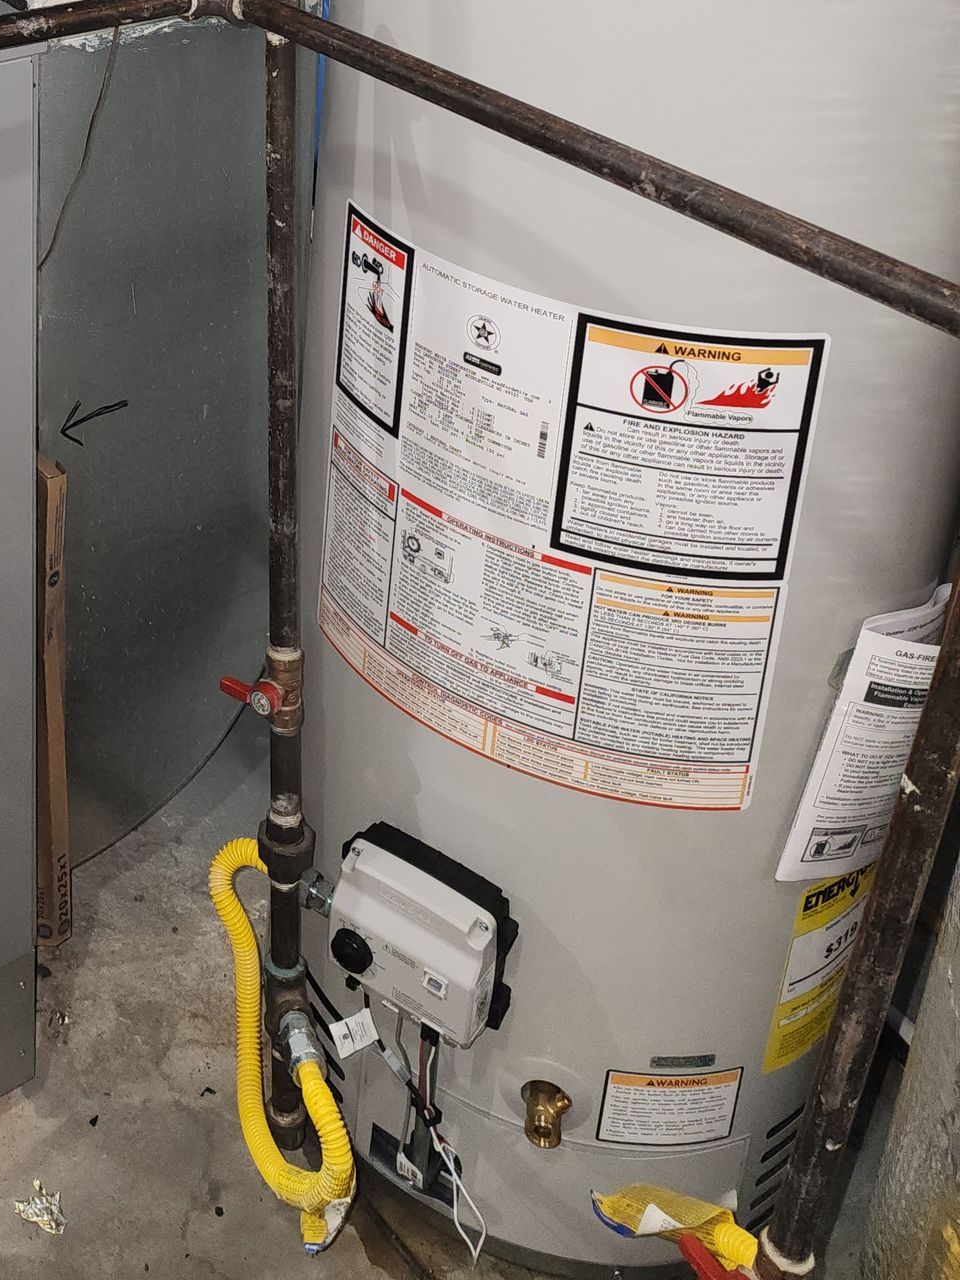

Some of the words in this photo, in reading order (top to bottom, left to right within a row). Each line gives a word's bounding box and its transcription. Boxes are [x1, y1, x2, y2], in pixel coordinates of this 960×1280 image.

[364, 231, 397, 261] DANGER
[422, 262, 461, 286] AUTOMATIC
[462, 282, 498, 300] STORAGE
[500, 296, 529, 311] WATER
[531, 306, 565, 321] HEATER
[674, 346, 741, 361] WARNING
[687, 411, 726, 420] Flammable
[728, 414, 752, 422] Vapors
[662, 426, 709, 437] EXPLOSION
[712, 431, 745, 439] HAZARD
[669, 434, 692, 442] serious
[583, 431, 602, 440] liquids
[624, 440, 645, 449] vicinity
[659, 439, 686, 448] gasoline
[603, 443, 629, 452] gasoline
[657, 452, 690, 462] flammable
[610, 450, 621, 458] any
[641, 457, 671, 465] appliance
[447, 517, 483, 538] OPERATING
[484, 534, 534, 558] INSTRUCTIONS
[677, 588, 714, 596] WARNING
[673, 612, 710, 620] WARNING
[424, 635, 433, 643] TO
[434, 639, 450, 653] TURN
[450, 648, 463, 659] OFF
[464, 657, 478, 667] GAS
[480, 664, 488, 672] TO
[490, 669, 528, 688] APPLIANCE
[870, 683, 907, 694] Installation
[659, 692, 692, 700] CALIFORNIA
[874, 691, 909, 701] Flammable
[824, 921, 858, 960] $319
[656, 1078, 708, 1087] WARNING
